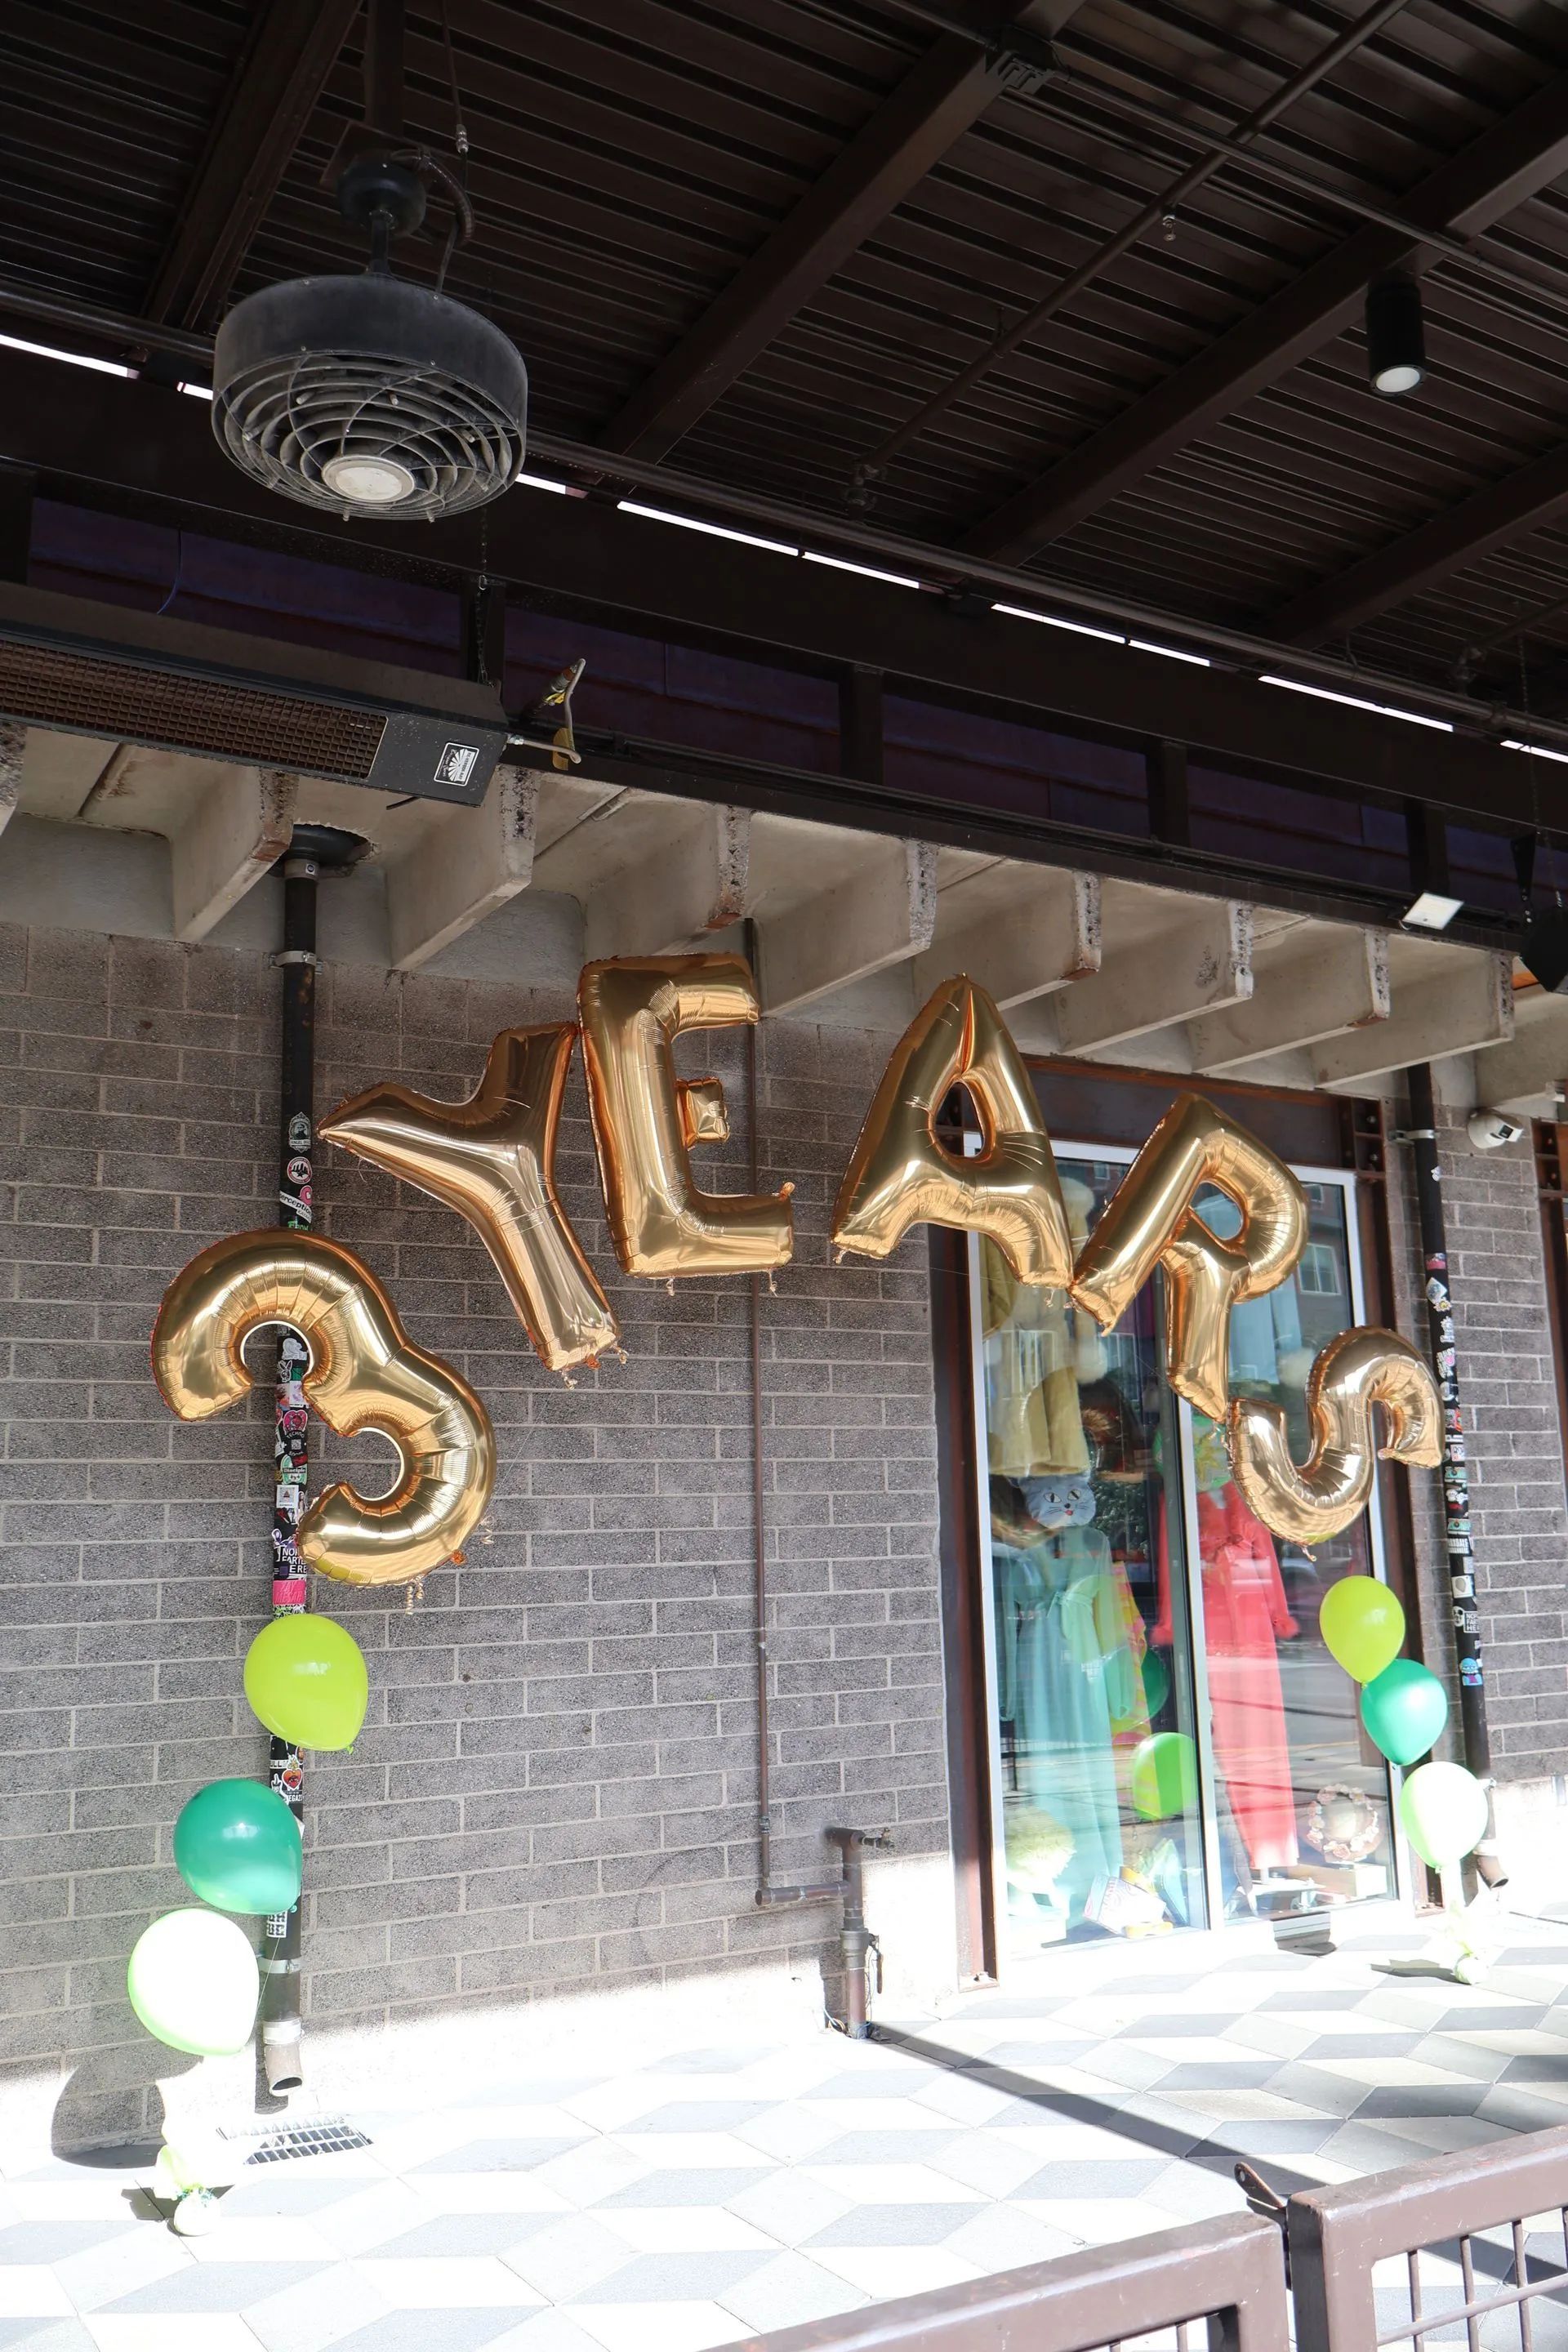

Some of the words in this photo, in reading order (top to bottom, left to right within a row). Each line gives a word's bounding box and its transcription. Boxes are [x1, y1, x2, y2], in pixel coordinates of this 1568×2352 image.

[318, 951, 1445, 1546] YEARS
[154, 1229, 495, 1587] 3
[282, 1548, 297, 1556] NO
[289, 1565, 307, 1573] ERE
